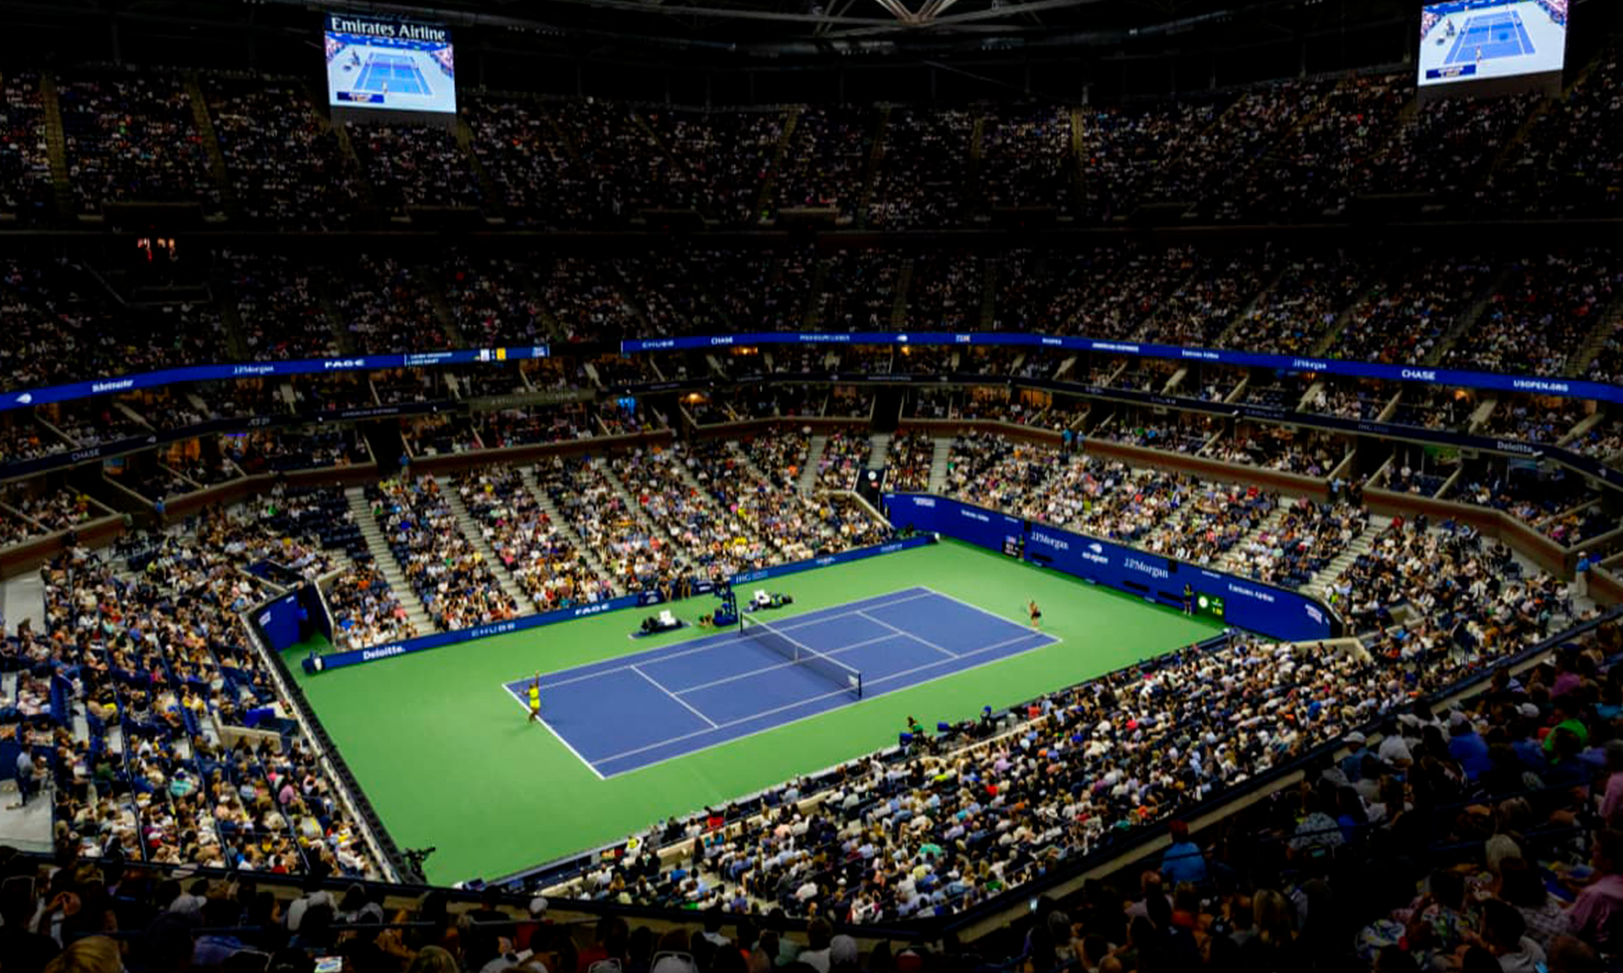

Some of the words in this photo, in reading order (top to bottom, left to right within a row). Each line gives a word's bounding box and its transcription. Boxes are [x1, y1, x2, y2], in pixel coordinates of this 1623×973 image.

[331, 17, 395, 37] Emirates
[399, 24, 446, 41] Airline
[1402, 369, 1436, 381] CHASE
